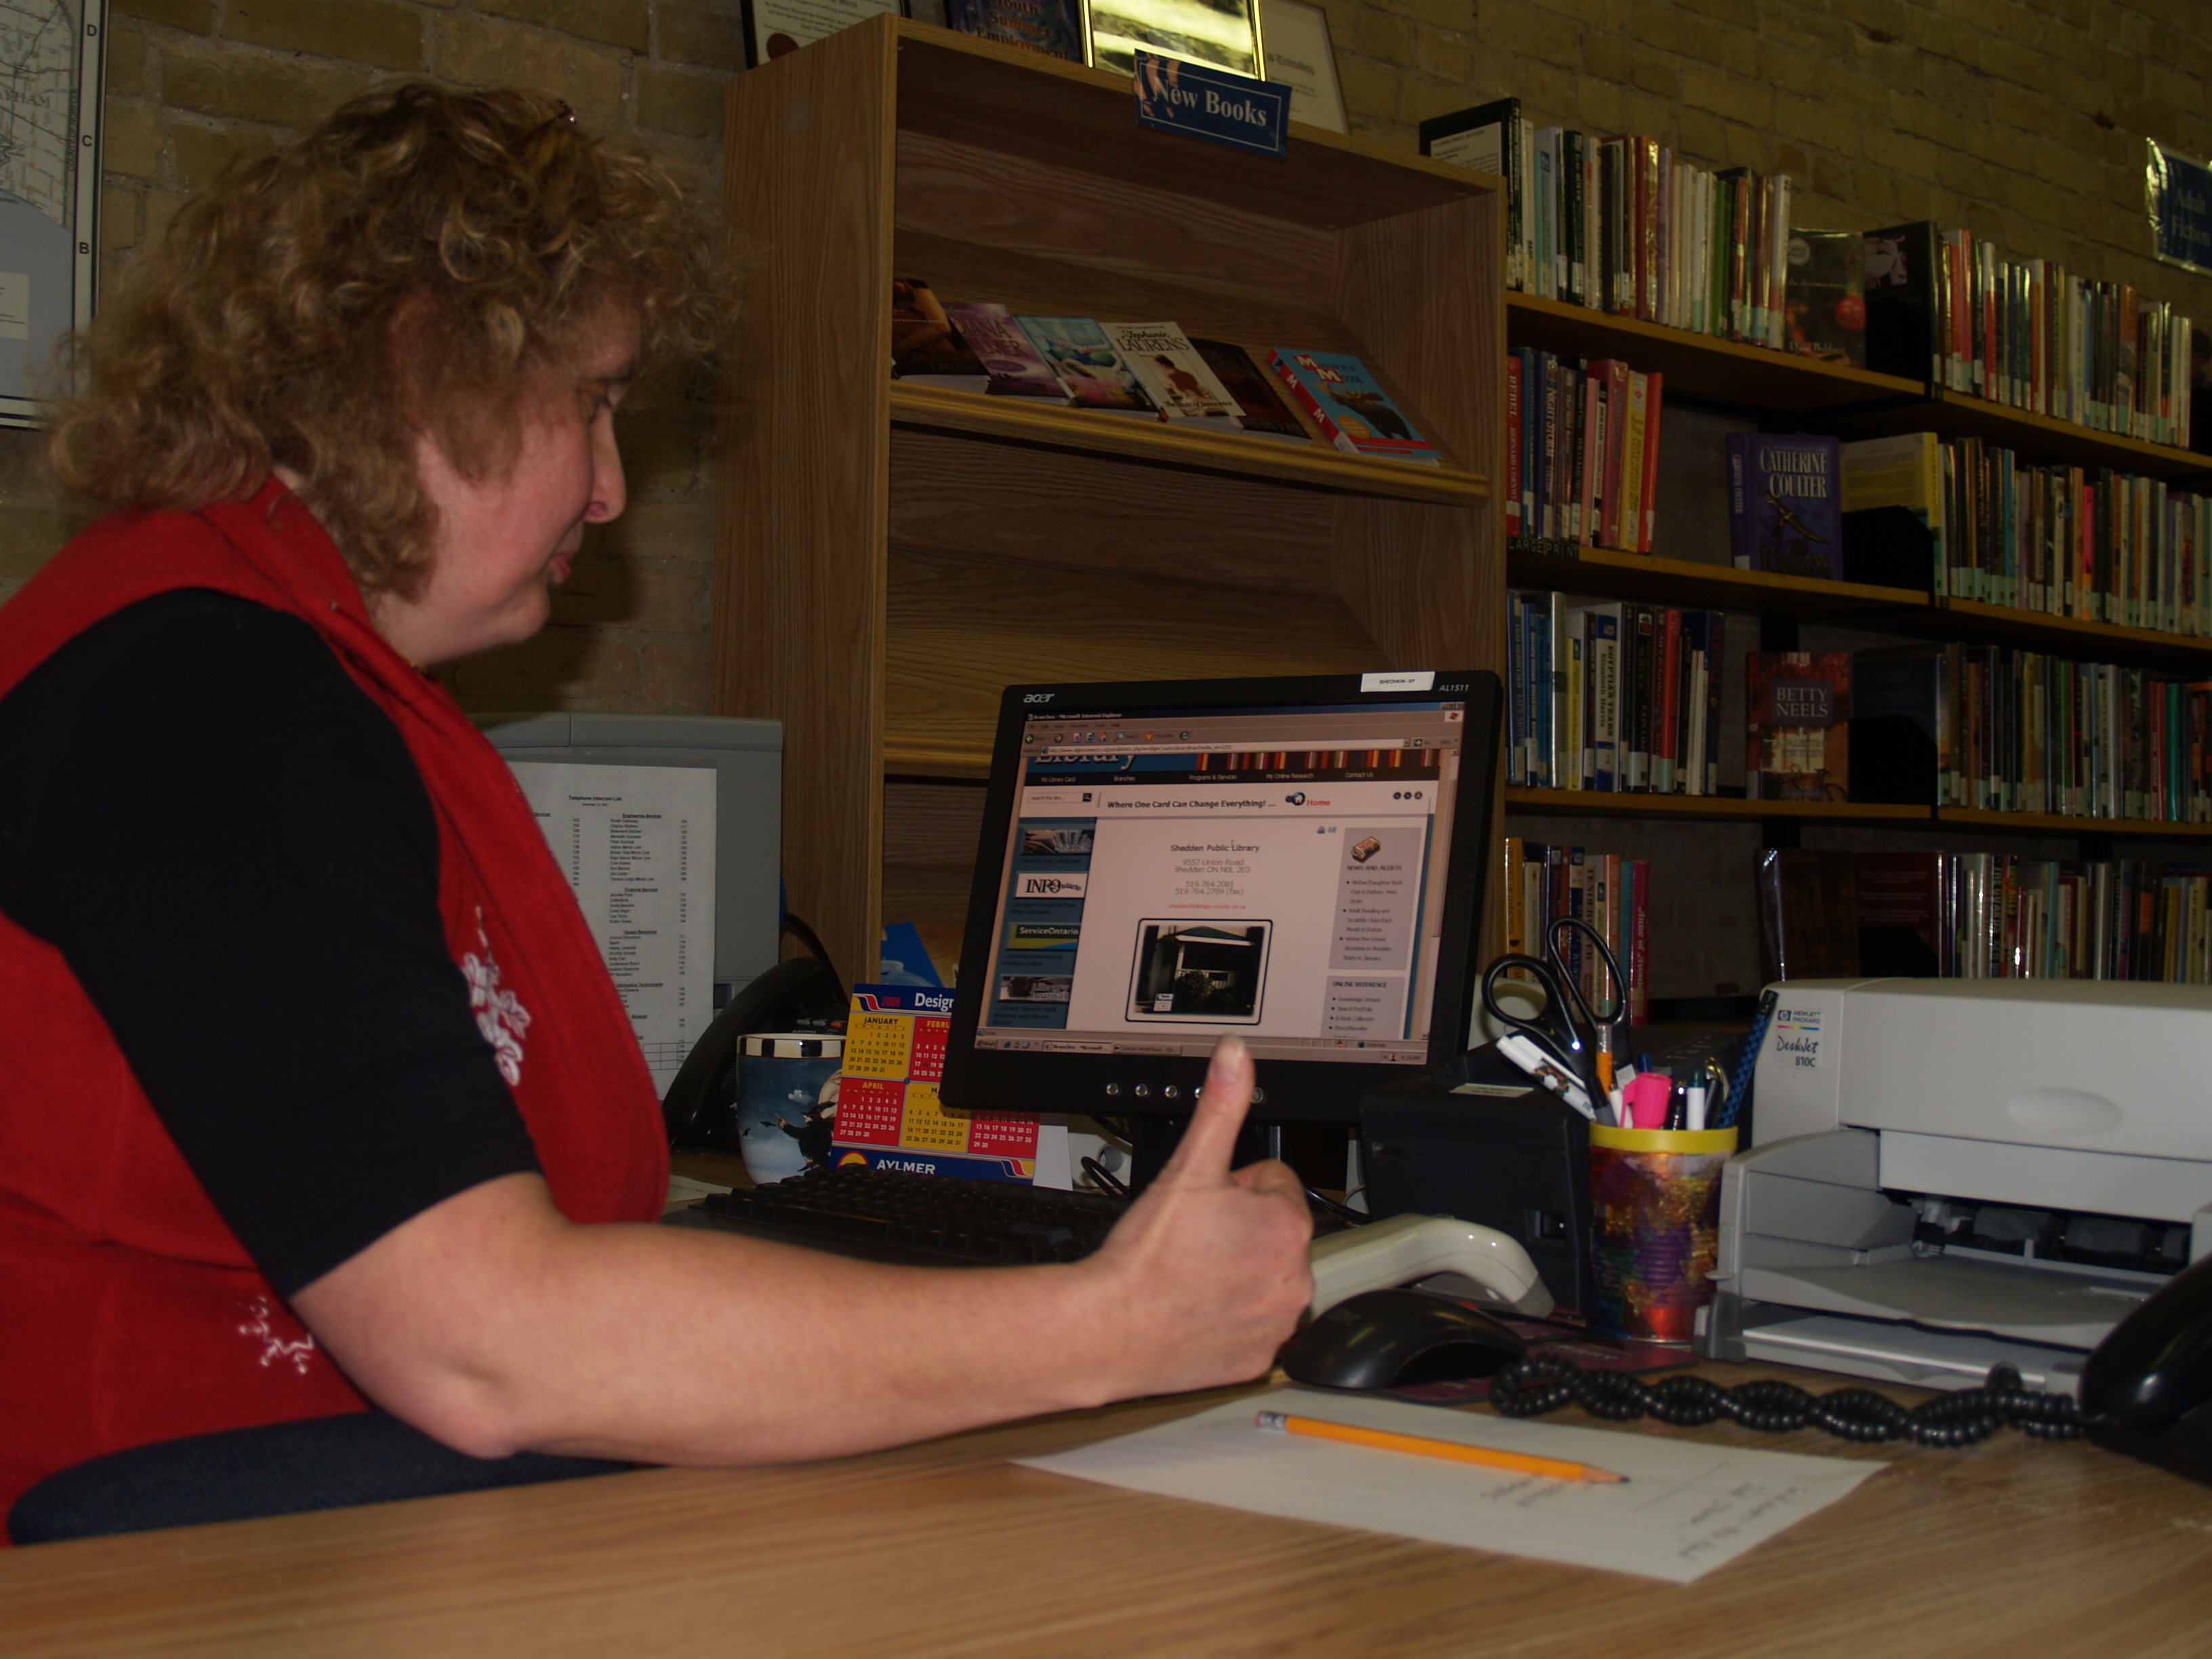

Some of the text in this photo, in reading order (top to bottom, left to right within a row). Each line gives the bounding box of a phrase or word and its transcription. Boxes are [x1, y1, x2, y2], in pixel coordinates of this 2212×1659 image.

[87, 24, 97, 37] D
[1153, 76, 1267, 127] New Books
[82, 135, 93, 147] C
[79, 242, 89, 255] B
[1118, 337, 1191, 352] LAURENS
[1509, 375, 1517, 419] REBEL
[1761, 446, 1828, 474] CATHERINE
[1769, 473, 1828, 499] COULTER
[1508, 540, 1579, 558] LARGE PRINT
[1439, 684, 1469, 692] AL1511
[1776, 687, 1828, 702] BETTY
[1023, 692, 1055, 704] acer
[1776, 703, 1828, 718] NEELS
[1189, 800, 1218, 809] Change
[1221, 800, 1267, 809] Everything!
[1231, 844, 1259, 853] Library
[1019, 926, 1079, 936] ServiceOntario
[926, 1020, 951, 1029] FEBRU
[1777, 1036, 1819, 1054] DeskJet
[1795, 1056, 1816, 1068] 810C
[862, 1082, 884, 1090] APRIL
[876, 1160, 936, 1175] AYLMER
